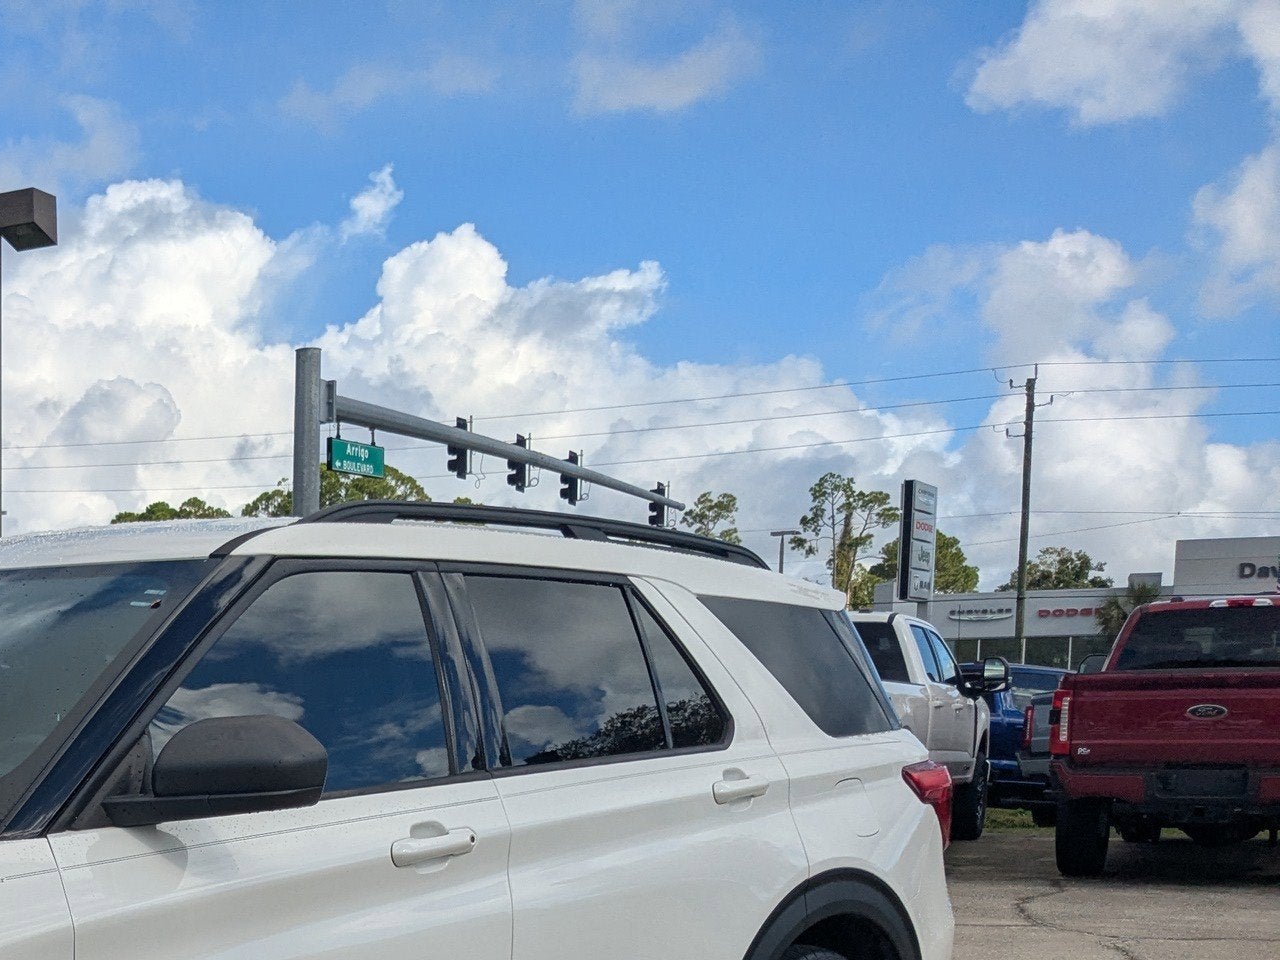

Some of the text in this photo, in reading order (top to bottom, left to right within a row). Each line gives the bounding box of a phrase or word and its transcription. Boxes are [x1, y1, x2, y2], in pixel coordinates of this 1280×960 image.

[346, 443, 369, 461] Arrigo
[342, 460, 374, 474] BOULEVARD
[915, 521, 933, 533] DODGE
